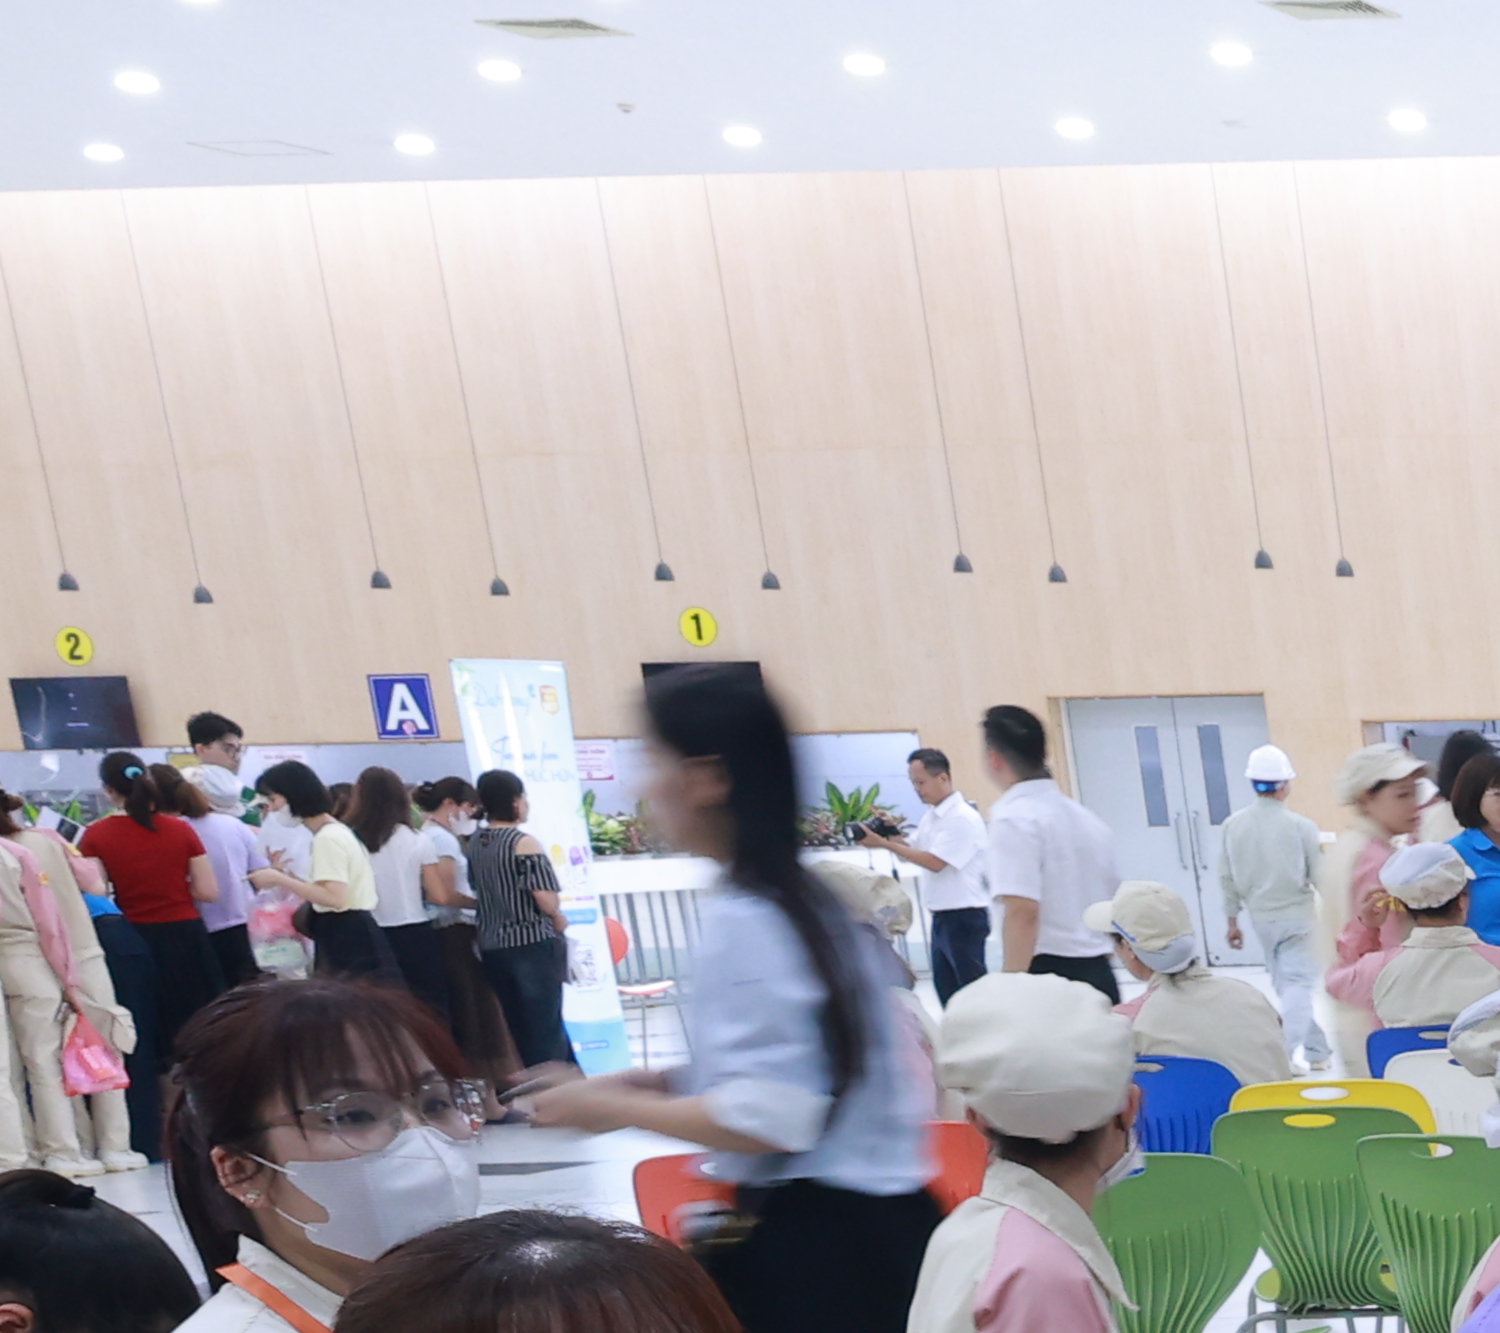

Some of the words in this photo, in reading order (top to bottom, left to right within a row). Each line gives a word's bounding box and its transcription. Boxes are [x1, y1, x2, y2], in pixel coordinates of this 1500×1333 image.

[690, 613, 705, 642] 1
[65, 632, 84, 660] 2
[386, 681, 433, 732] A
